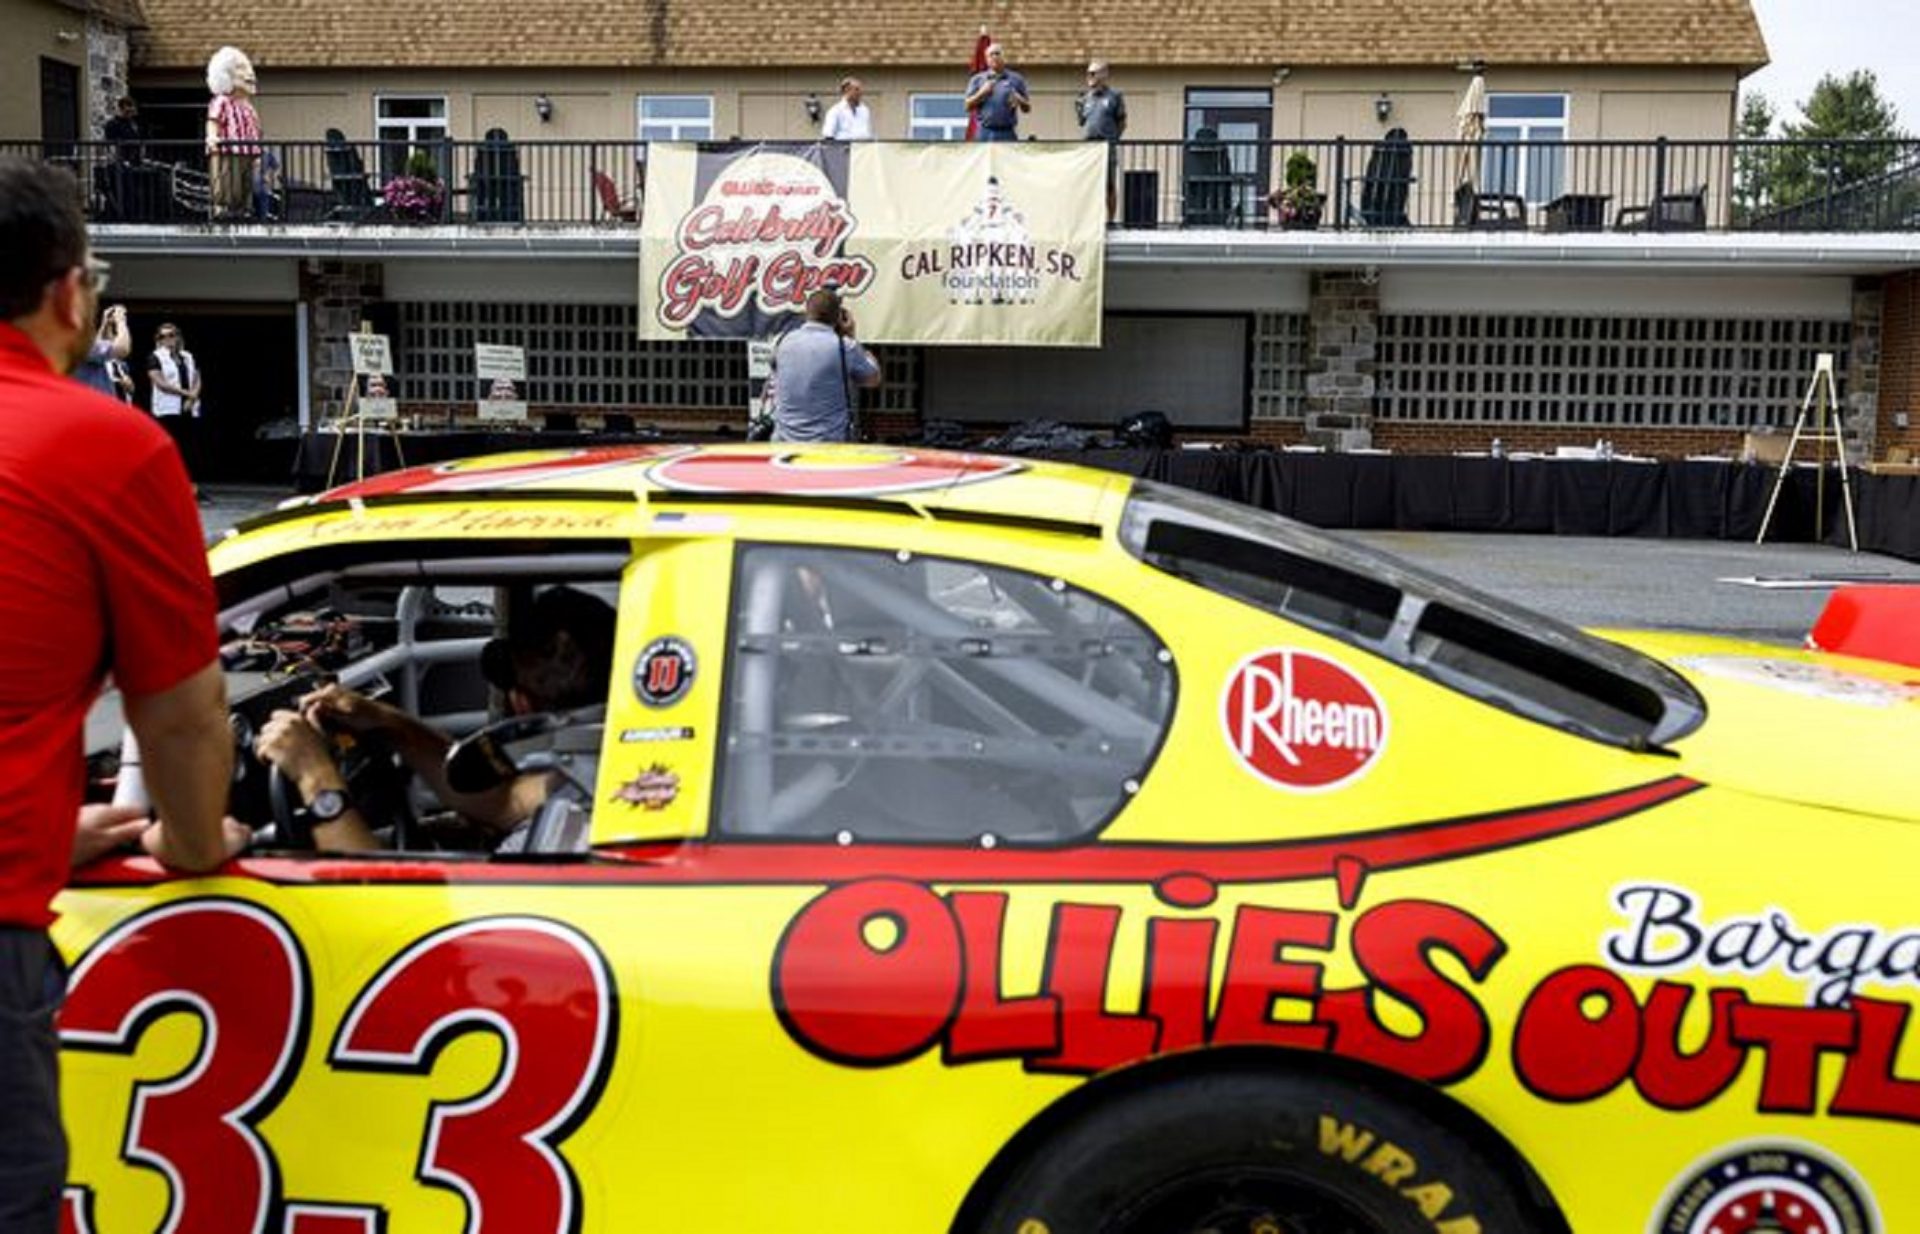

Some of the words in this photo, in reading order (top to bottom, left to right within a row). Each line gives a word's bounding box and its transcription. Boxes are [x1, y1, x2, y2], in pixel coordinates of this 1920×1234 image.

[684, 202, 850, 258] Celebrity
[664, 254, 760, 321] Golf
[762, 250, 870, 304] Open
[901, 250, 942, 280] CAL
[950, 243, 1040, 274] RIPKEN,
[1046, 250, 1081, 281] SR.
[941, 271, 1040, 289] foundation
[1241, 650, 1379, 767] Rheem
[56, 895, 620, 1234] 33
